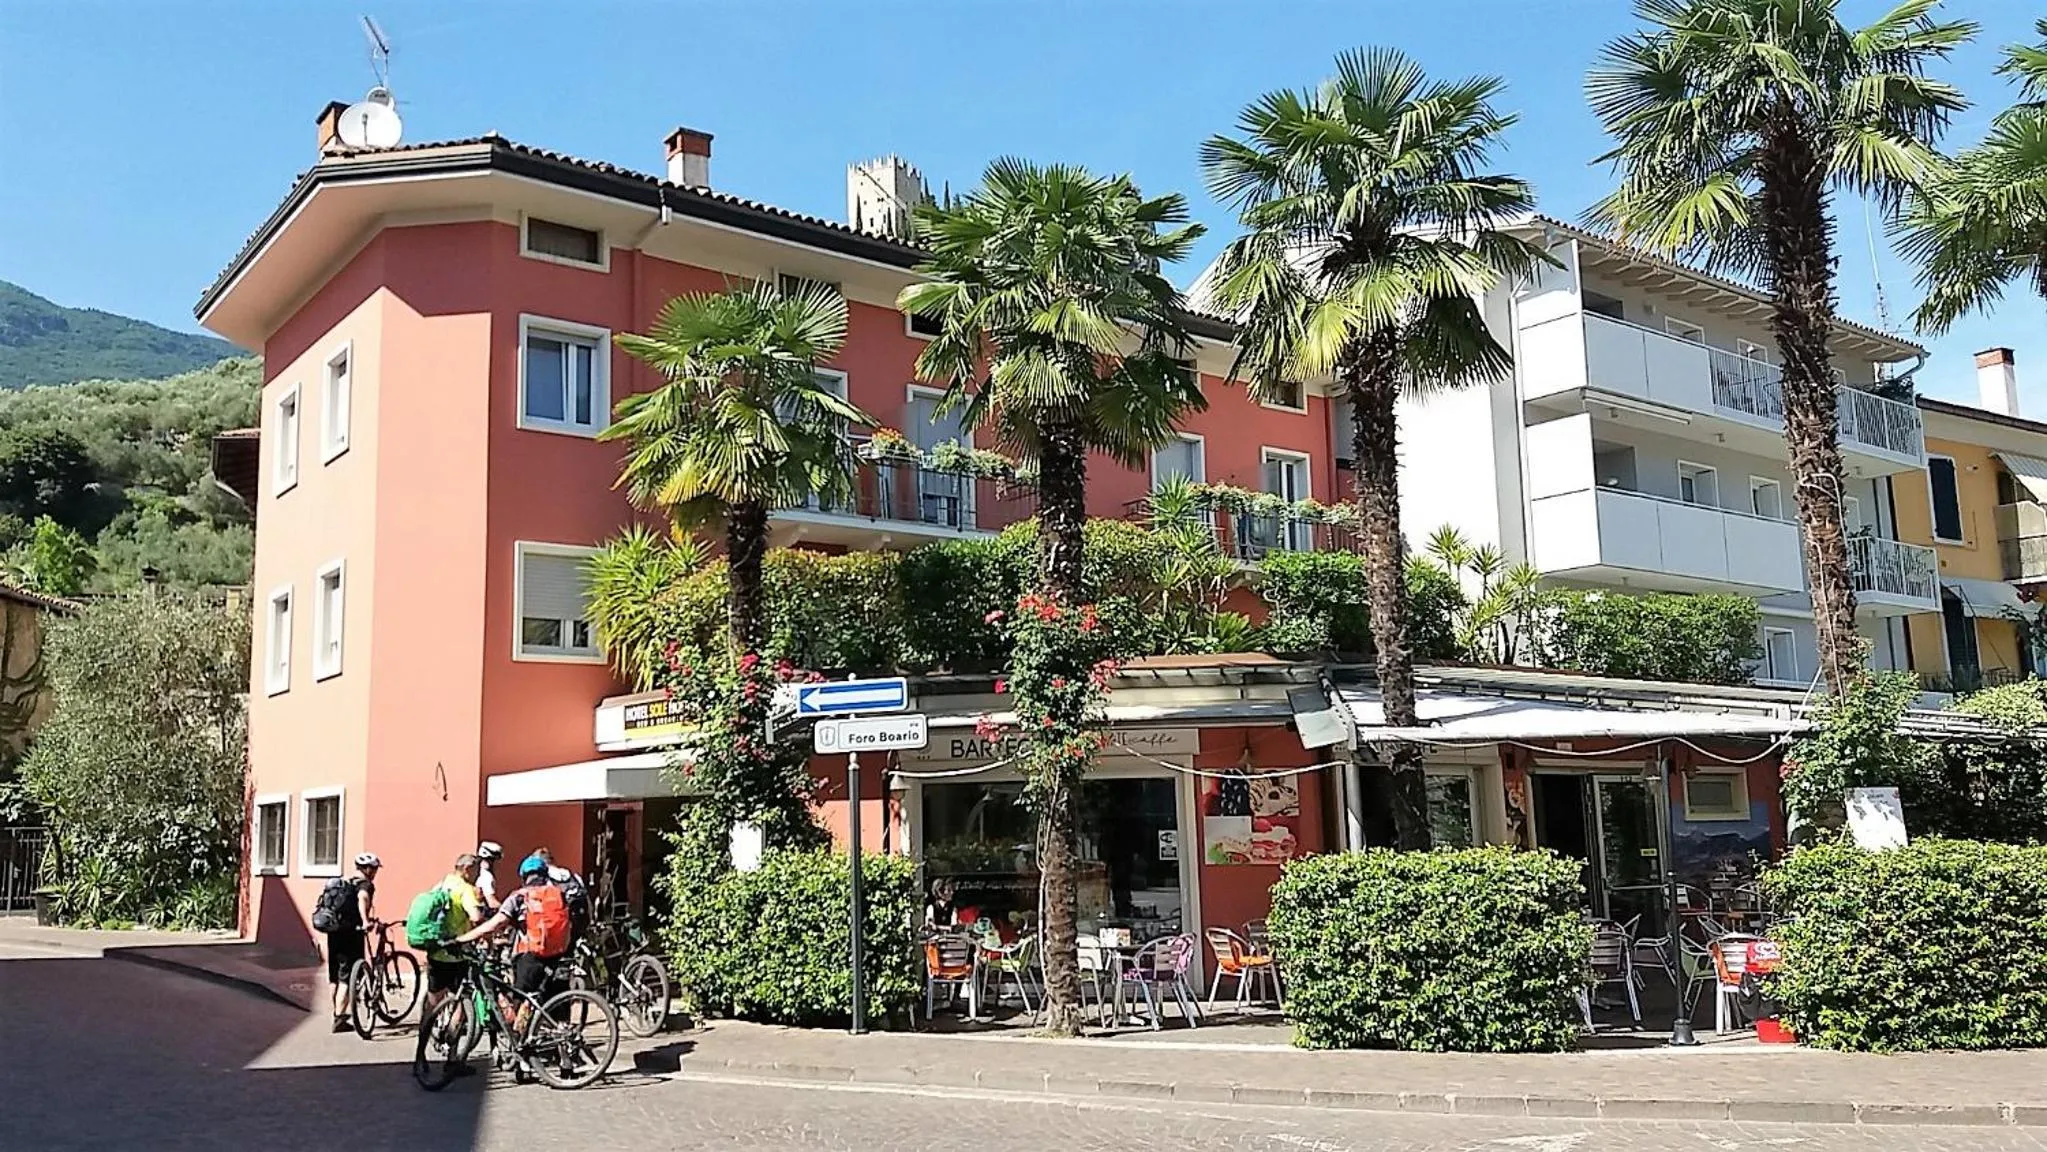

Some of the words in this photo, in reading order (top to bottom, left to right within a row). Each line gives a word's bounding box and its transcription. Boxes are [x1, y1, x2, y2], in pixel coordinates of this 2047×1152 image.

[626, 705, 648, 721] HOTEL
[649, 702, 668, 718] SOLE
[848, 733, 876, 744] Foro
[879, 730, 920, 742] Boario
